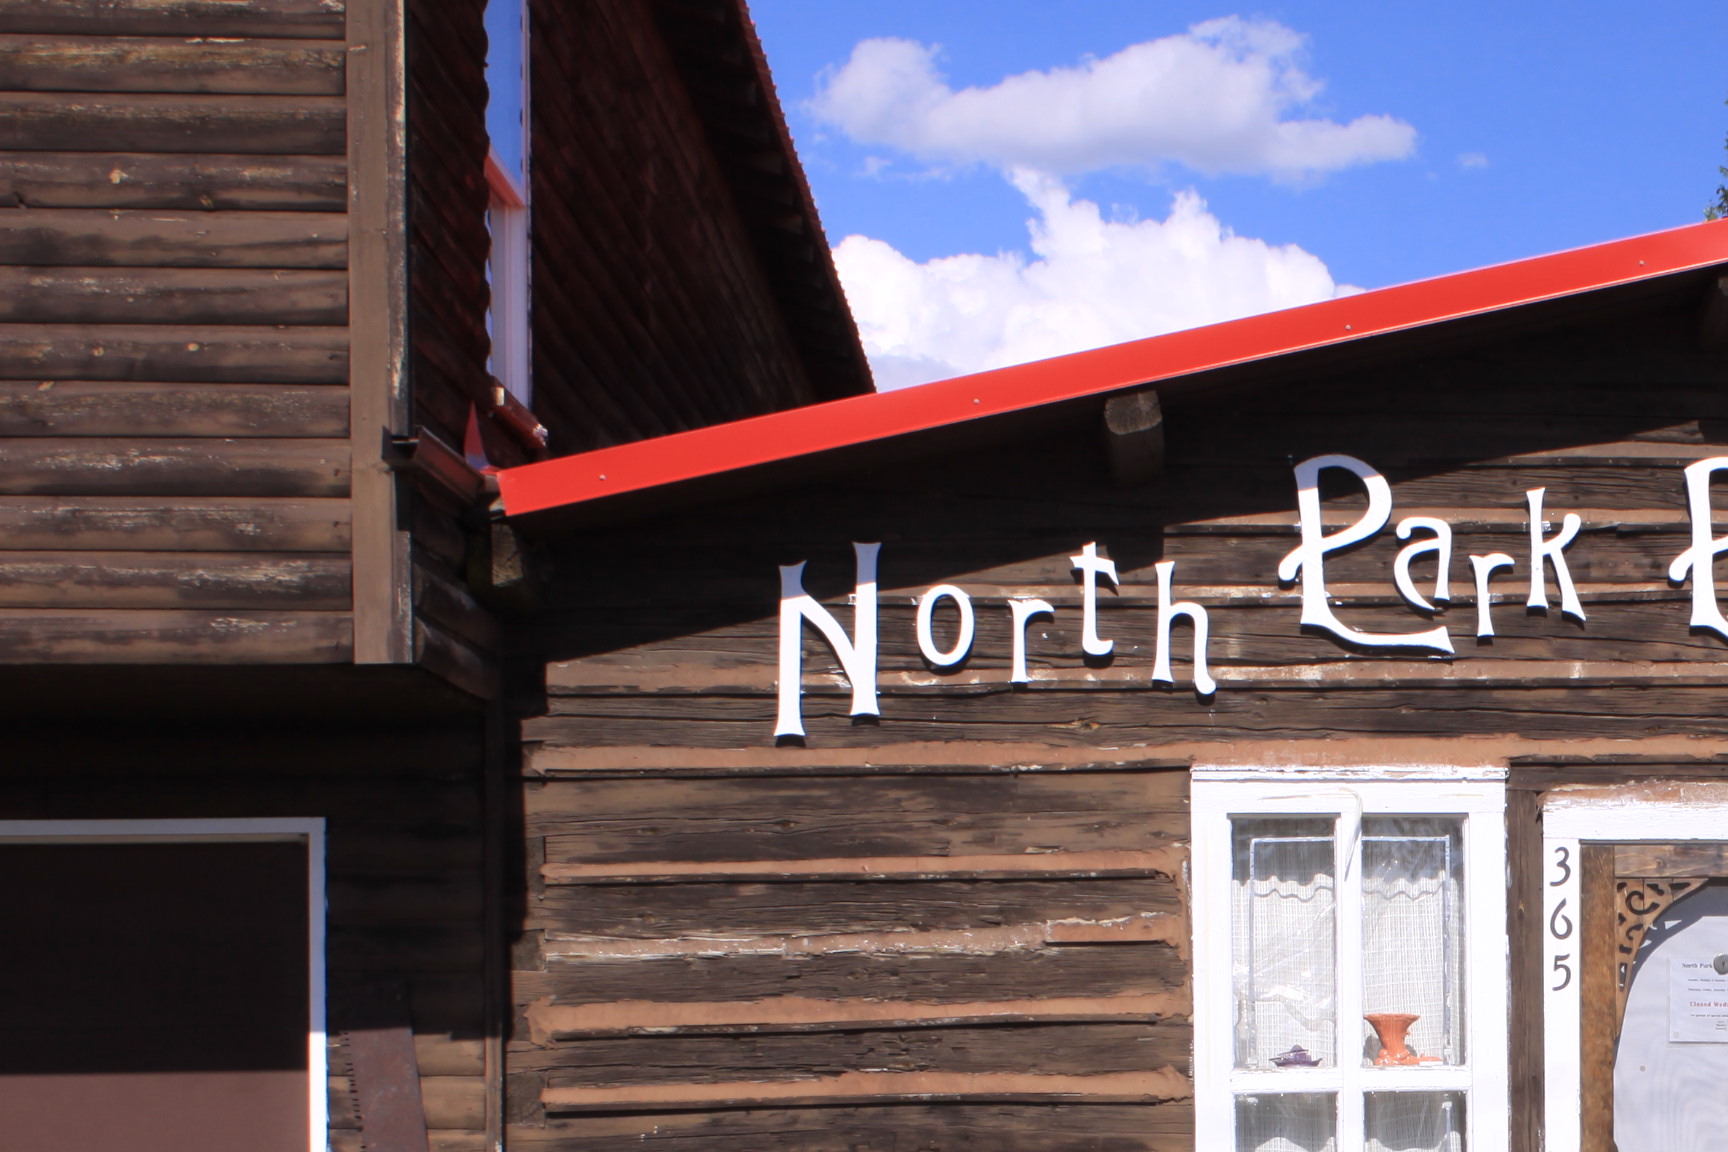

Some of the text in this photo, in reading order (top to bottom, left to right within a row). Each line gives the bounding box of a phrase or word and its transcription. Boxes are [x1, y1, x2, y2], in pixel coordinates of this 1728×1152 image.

[773, 542, 1218, 738] North
[1278, 455, 1586, 654] Park
[1550, 847, 1572, 991] 365
